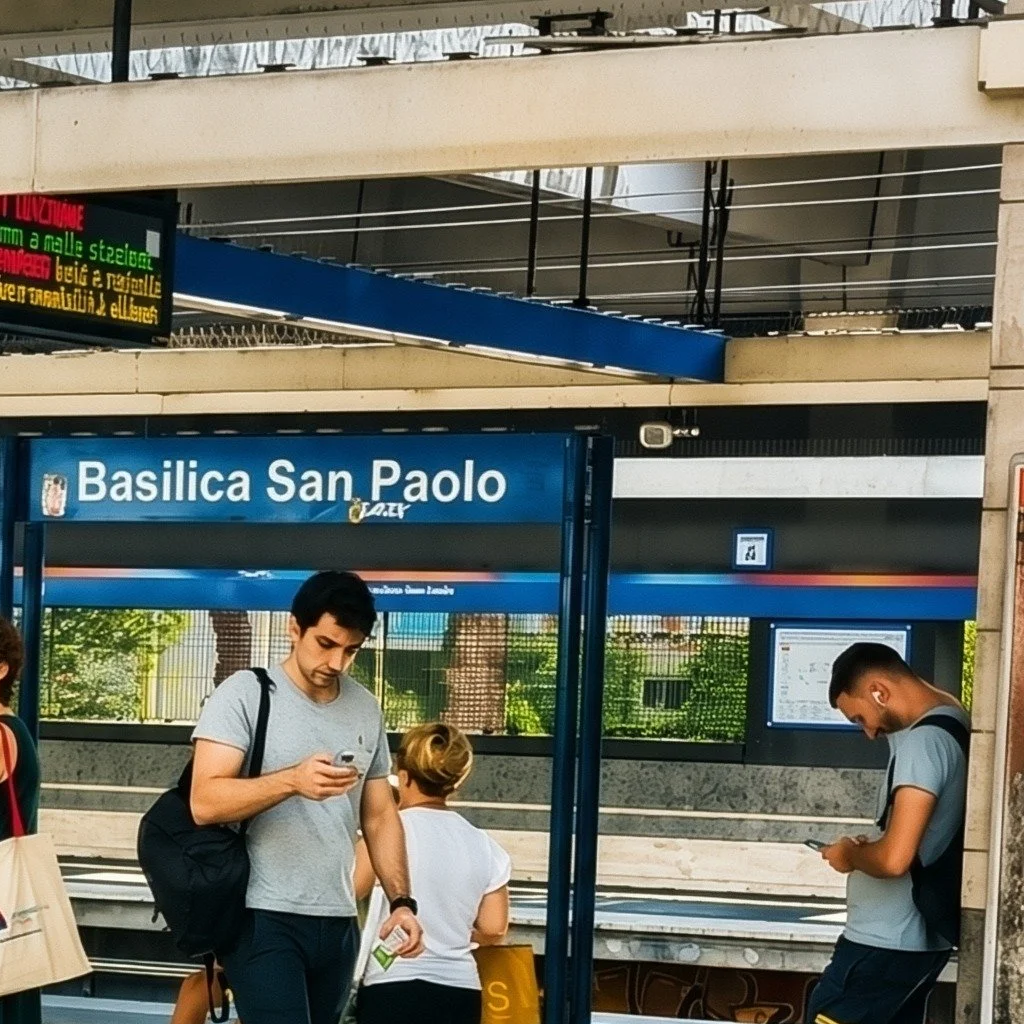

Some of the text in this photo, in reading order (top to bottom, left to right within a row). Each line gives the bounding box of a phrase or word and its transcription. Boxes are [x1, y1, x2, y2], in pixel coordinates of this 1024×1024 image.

[78, 459, 507, 502] Basilica San Paolo
[487, 981, 510, 1011] S
